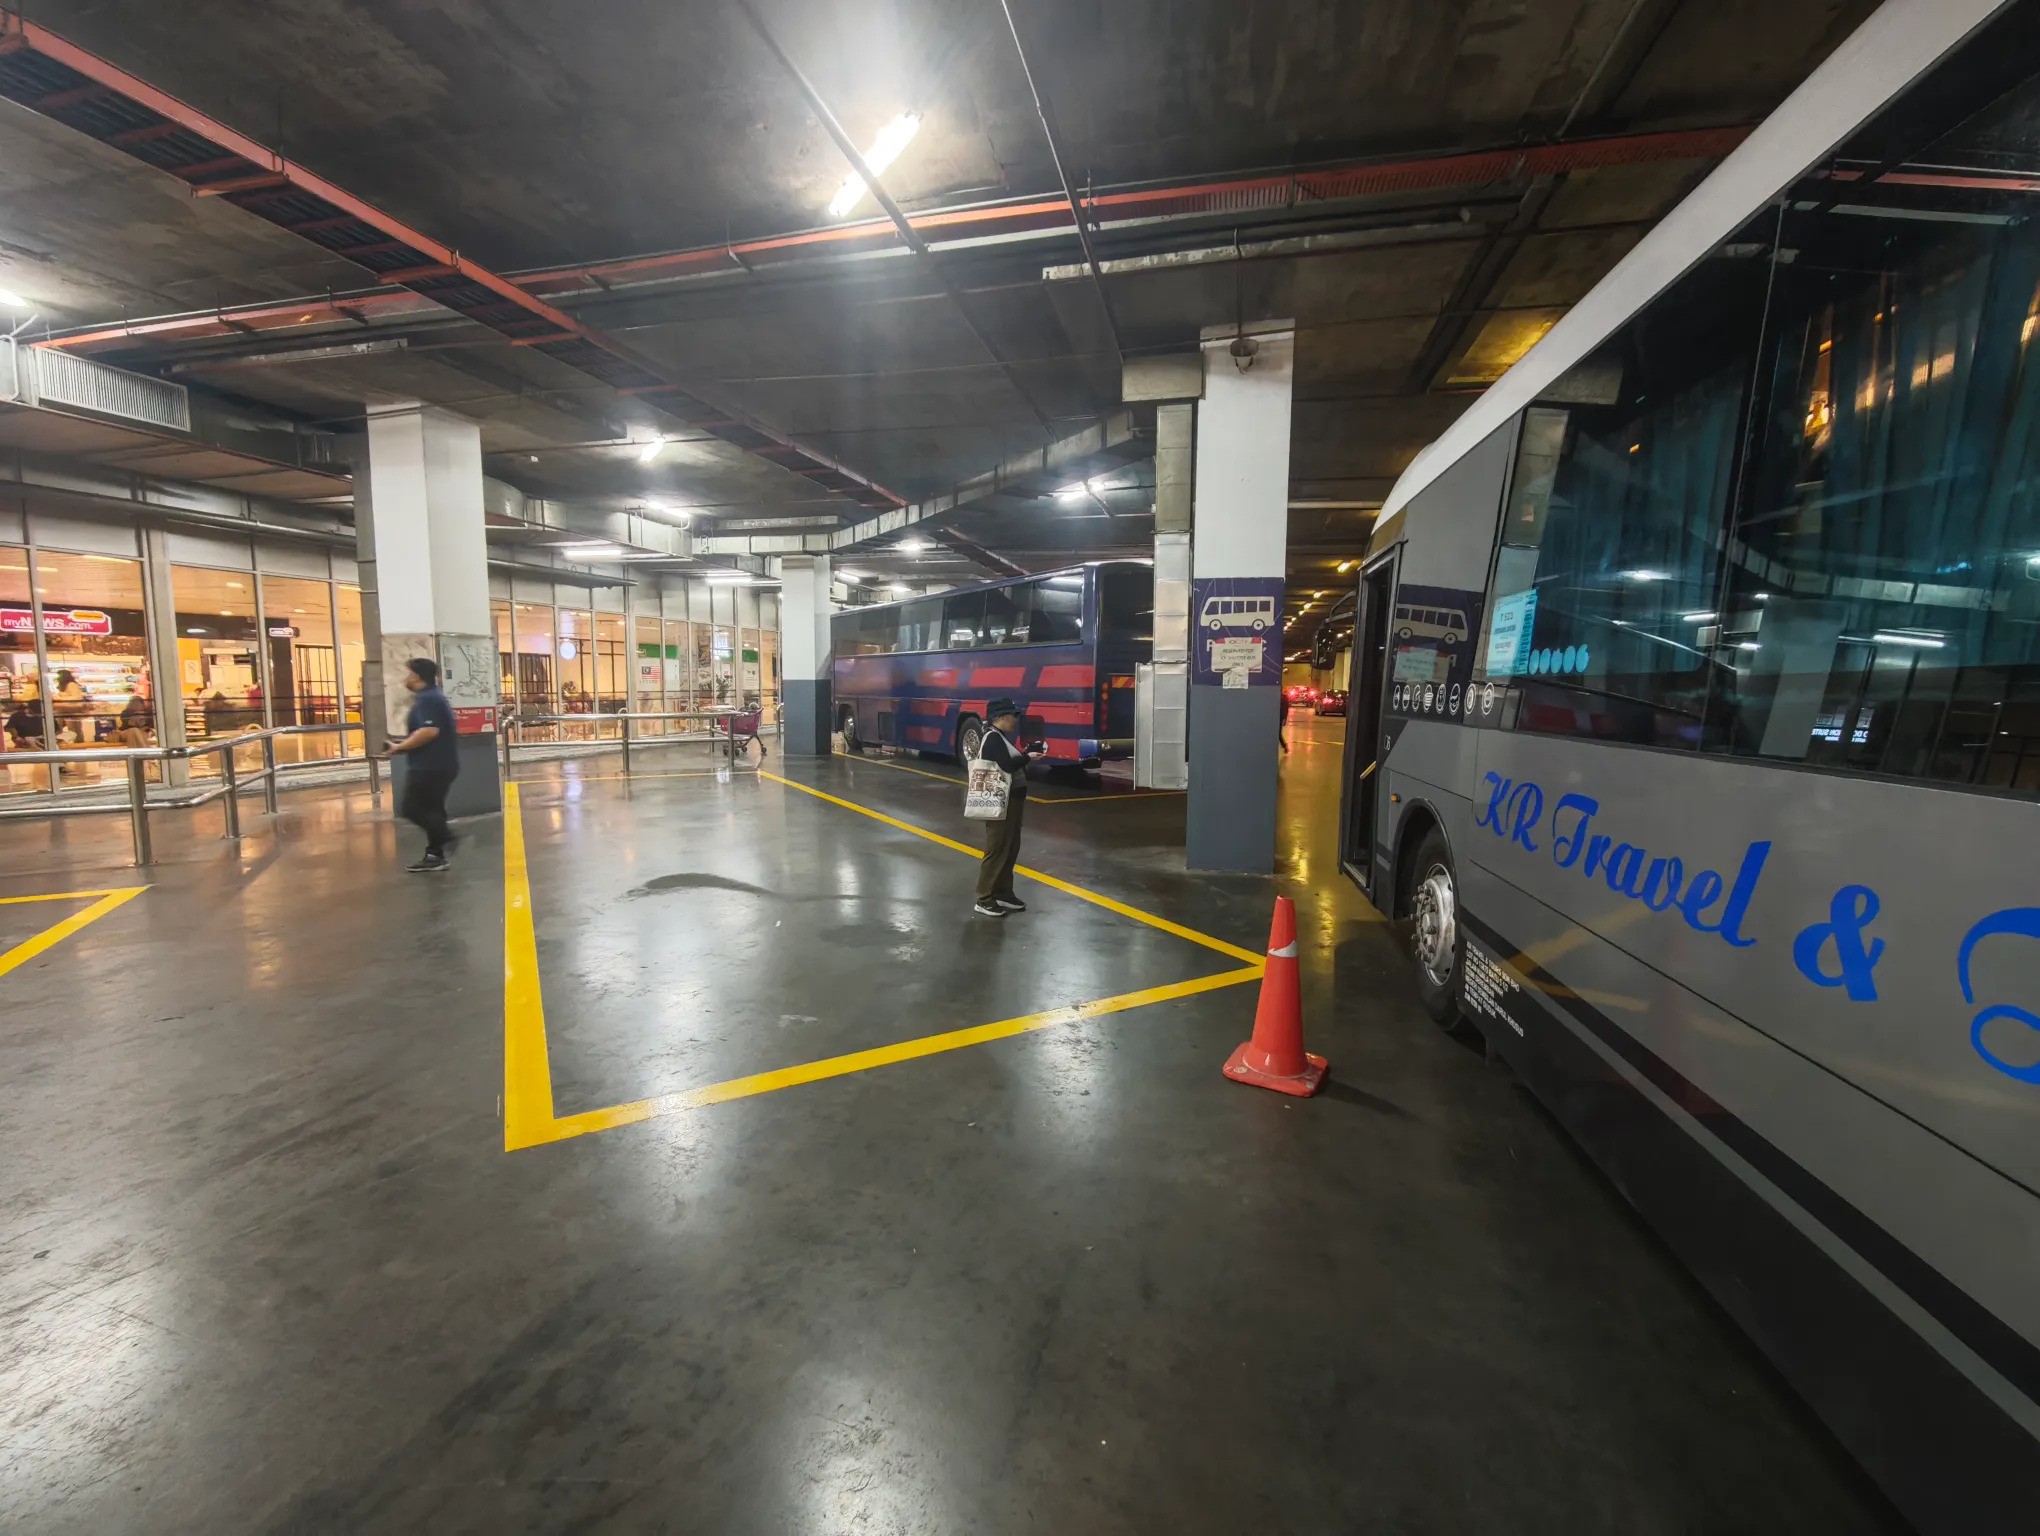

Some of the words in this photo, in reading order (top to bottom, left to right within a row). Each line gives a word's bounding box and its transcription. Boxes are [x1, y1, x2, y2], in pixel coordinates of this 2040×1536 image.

[4, 617, 93, 630] myNWS.com
[1476, 771, 1544, 852] KR
[1552, 793, 1771, 947] Travel
[1793, 885, 1886, 1002] &
